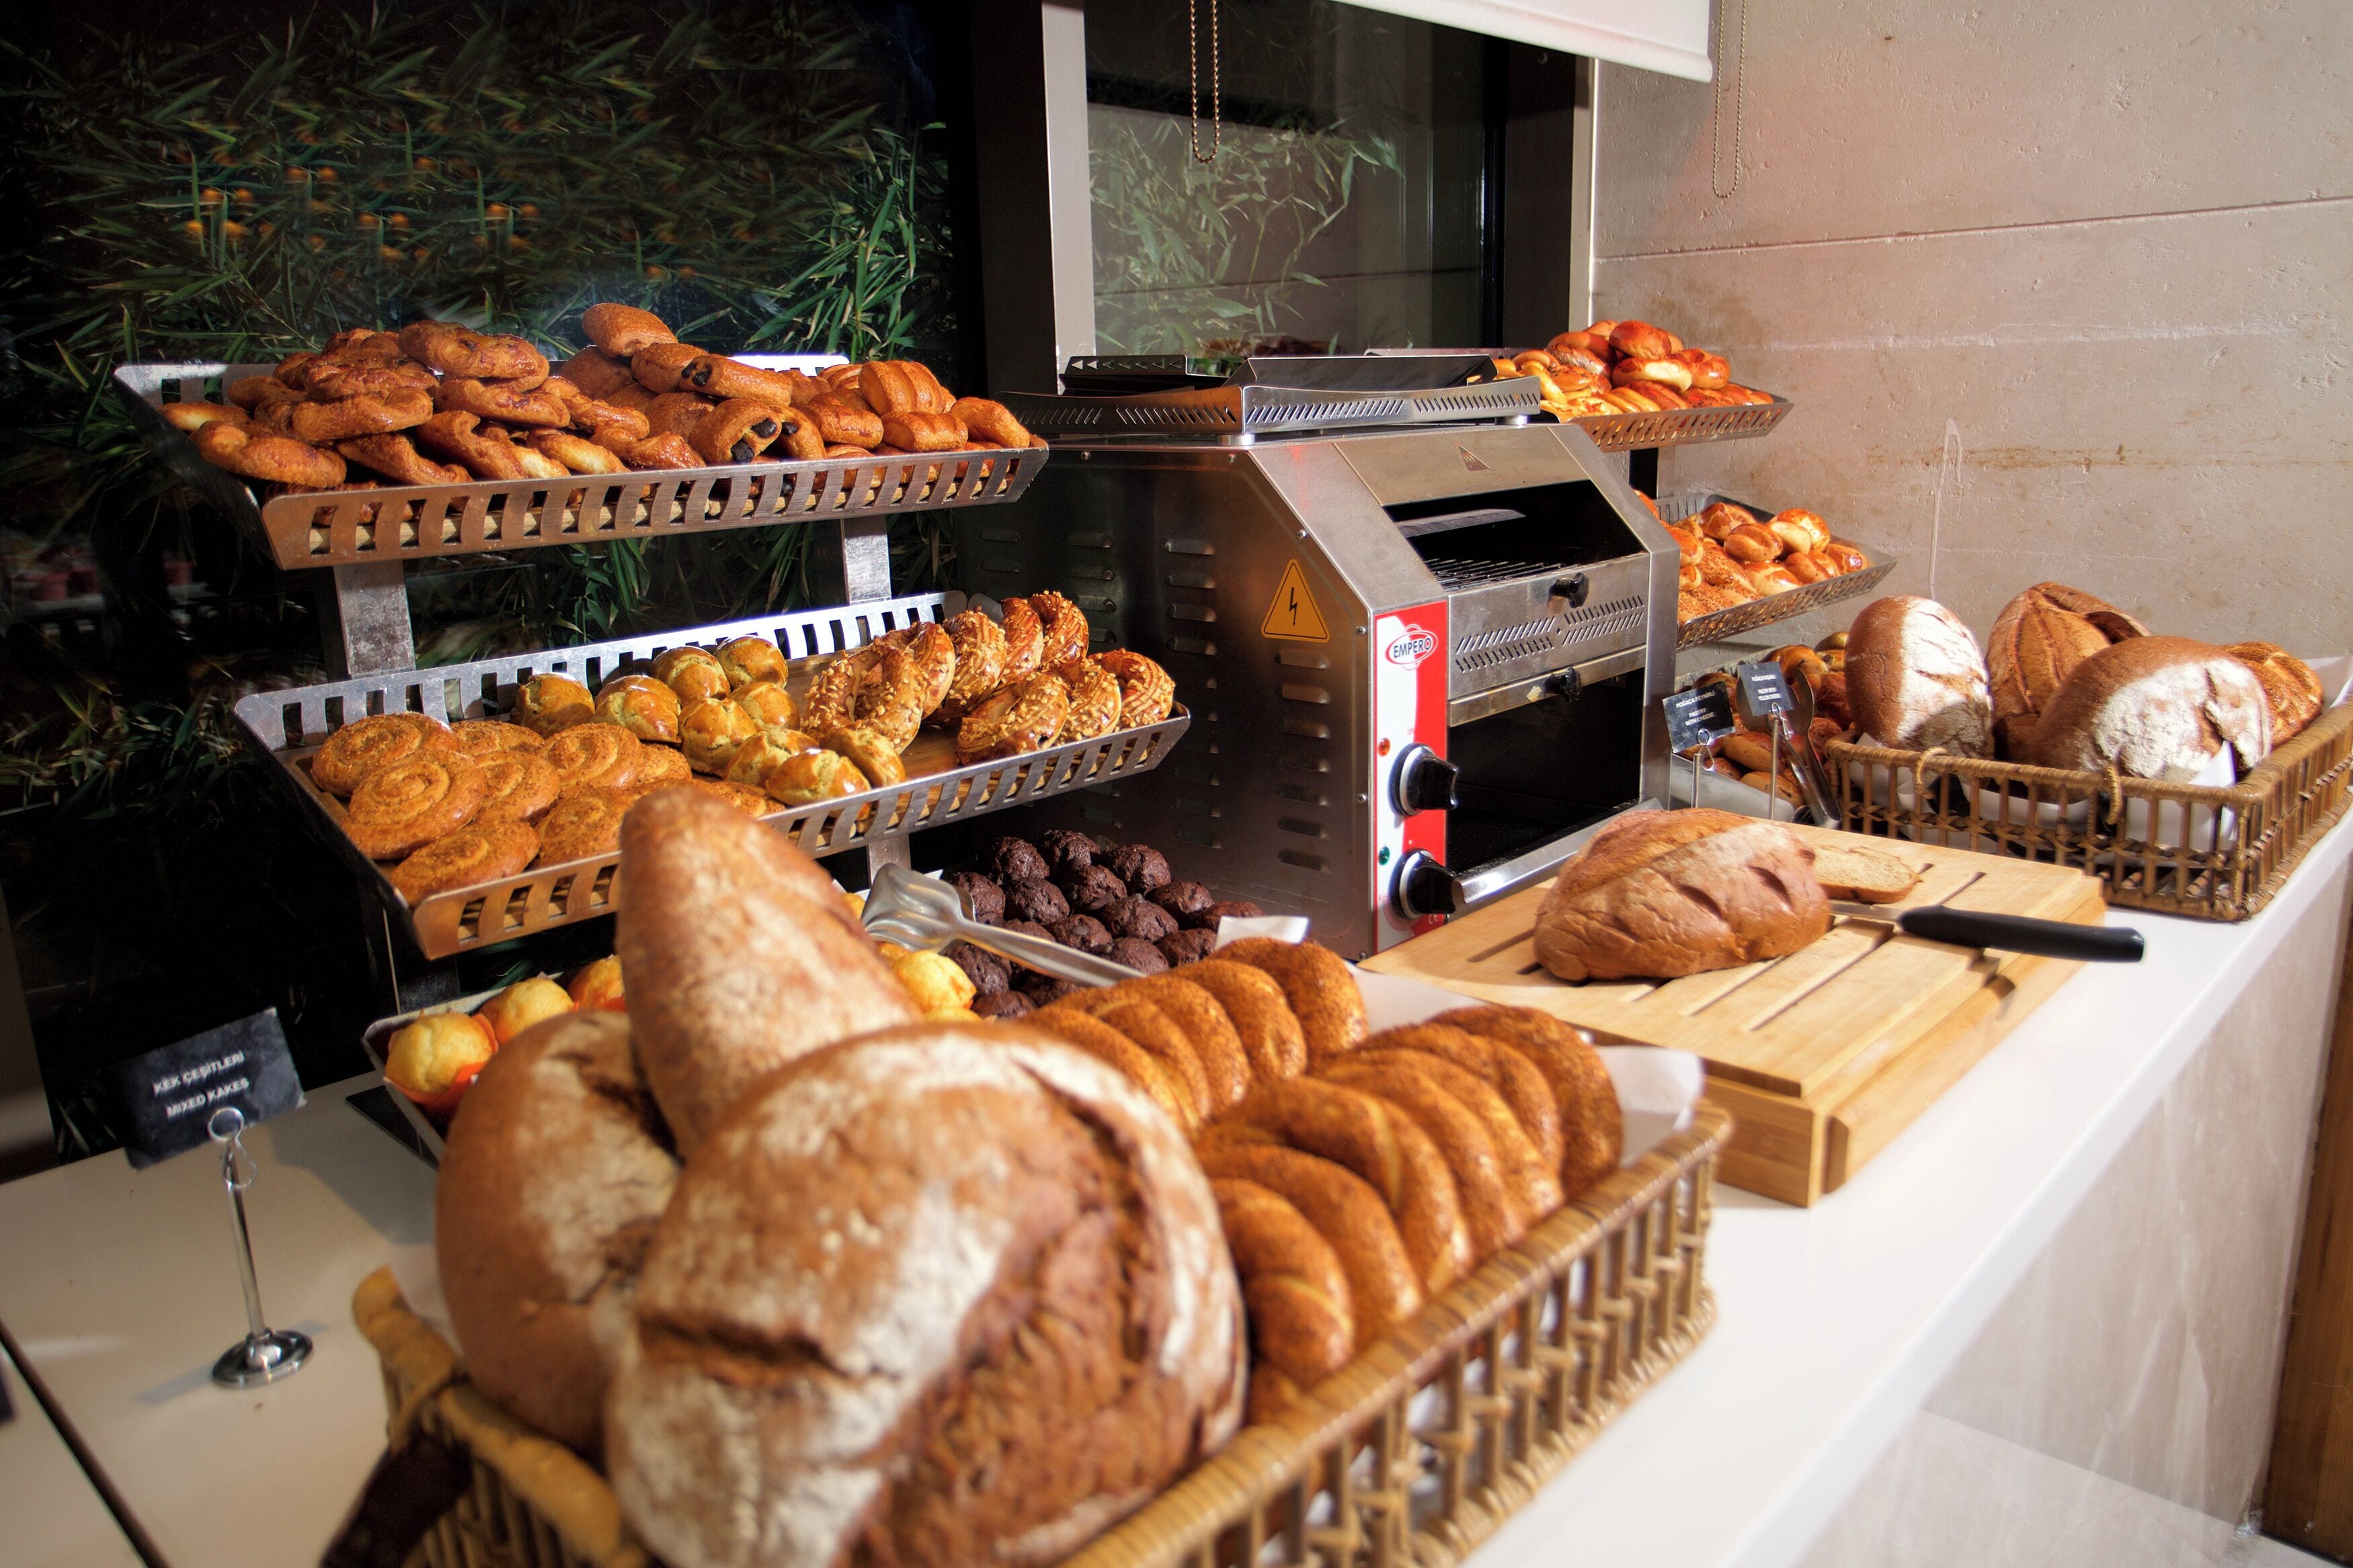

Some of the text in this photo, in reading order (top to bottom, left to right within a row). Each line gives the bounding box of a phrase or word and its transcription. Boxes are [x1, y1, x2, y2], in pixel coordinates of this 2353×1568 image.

[1394, 637, 1431, 659] EMPERO
[1675, 698, 1696, 708] POĞAÇA
[1685, 712, 1715, 727] WITH CHEESE
[1689, 708, 1706, 718] PASTRY
[153, 1050, 245, 1096] KEK ÇEŞİTLERİ
[165, 1077, 249, 1118] MIXED KAKES
